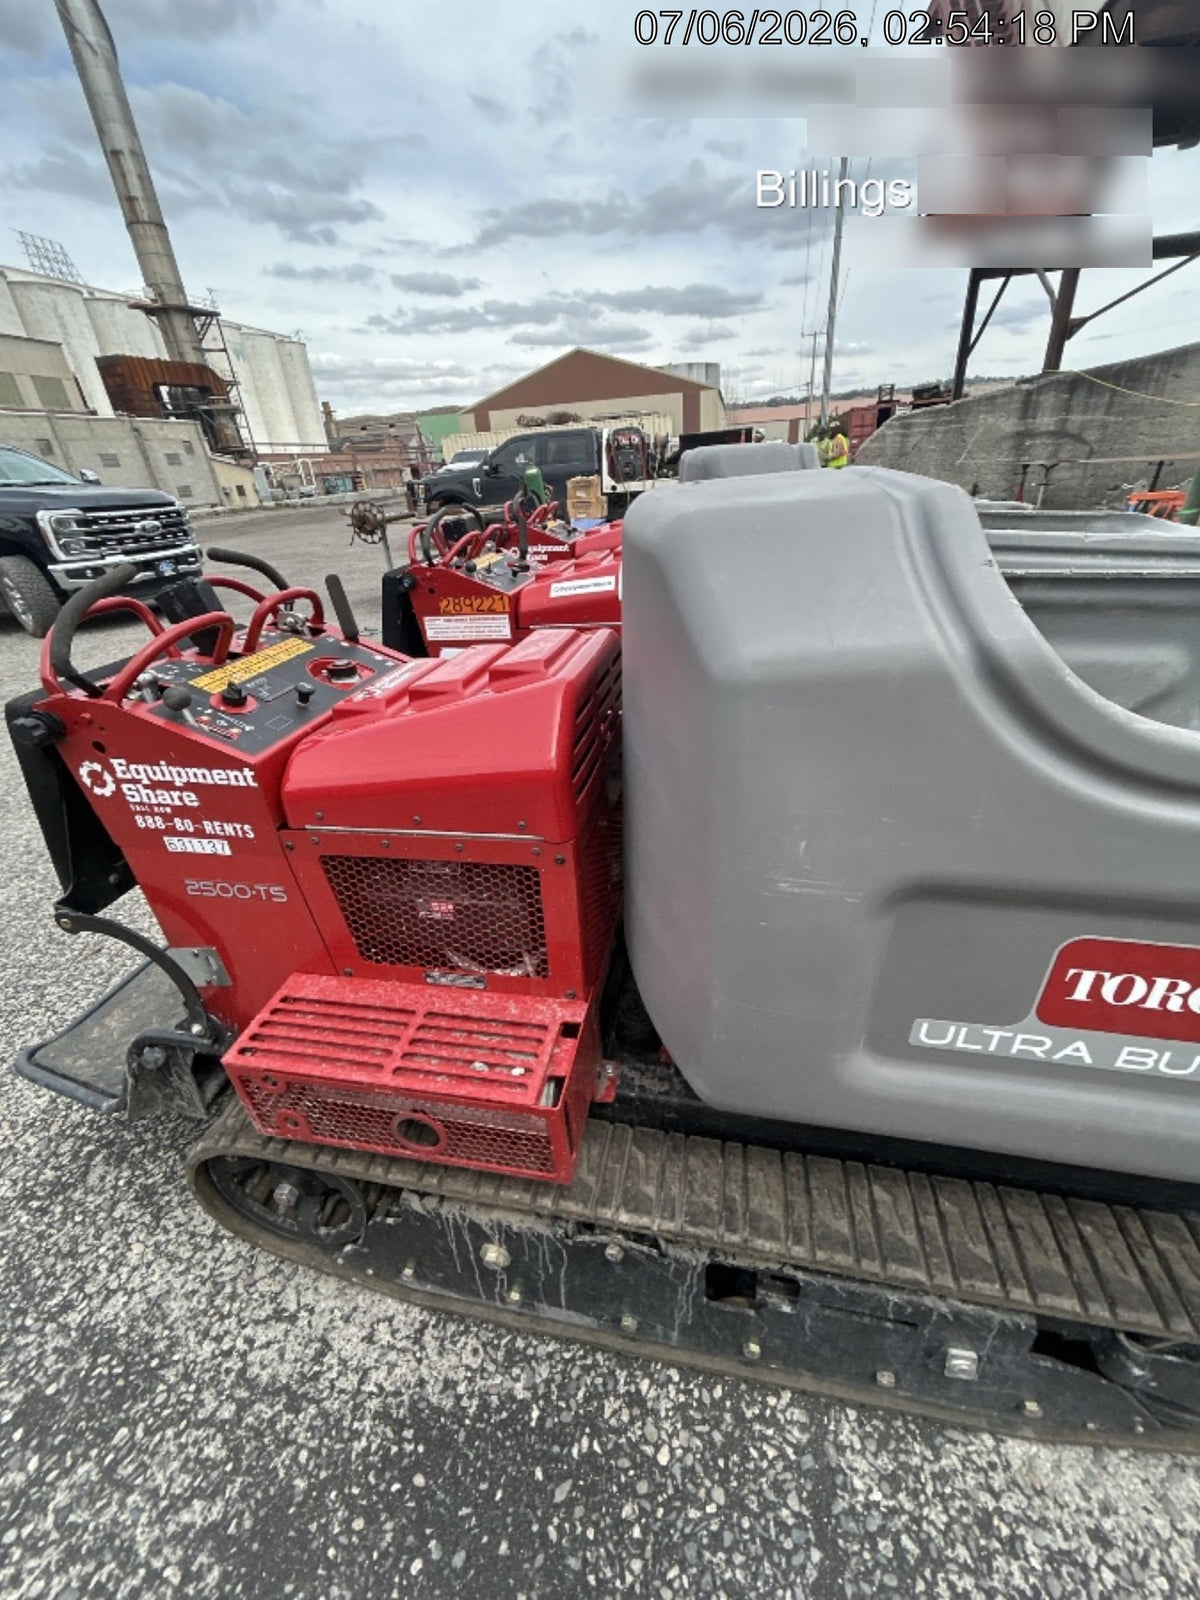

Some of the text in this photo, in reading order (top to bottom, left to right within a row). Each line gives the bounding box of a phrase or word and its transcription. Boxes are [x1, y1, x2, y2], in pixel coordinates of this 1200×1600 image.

[440, 595, 510, 614] 289221
[110, 758, 258, 787] Equipment
[120, 783, 200, 807] Share
[1064, 968, 1200, 1013] TOR
[918, 1021, 1093, 1065] ULTRA
